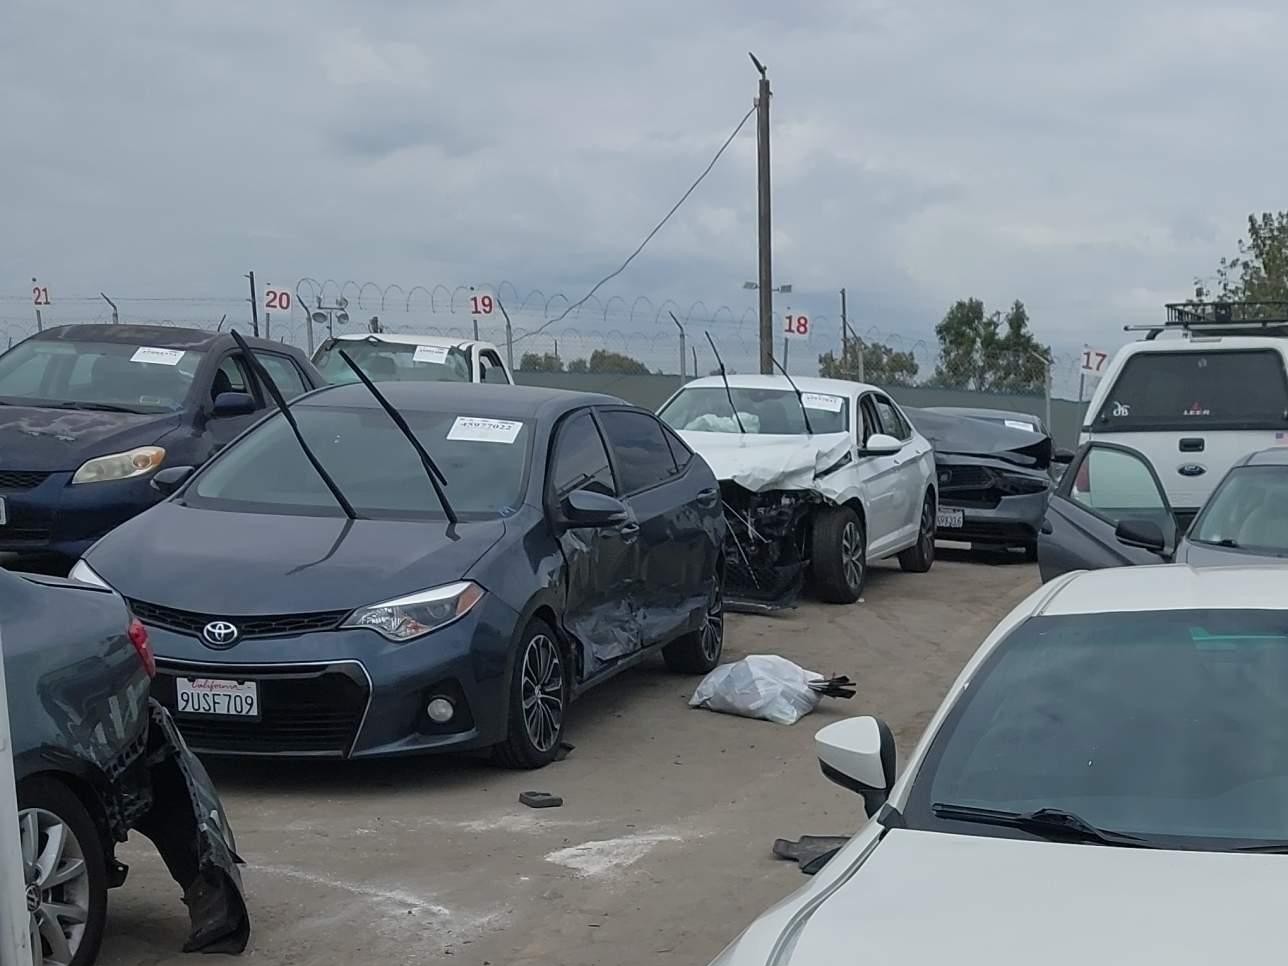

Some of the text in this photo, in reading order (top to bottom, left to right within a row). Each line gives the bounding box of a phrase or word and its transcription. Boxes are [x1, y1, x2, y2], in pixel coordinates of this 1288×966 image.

[32, 286, 51, 305] 21
[265, 290, 290, 310] 20
[470, 295, 493, 314] 19
[784, 314, 808, 335] 18
[1081, 351, 1107, 371] 17
[180, 691, 254, 715] 9USF709
